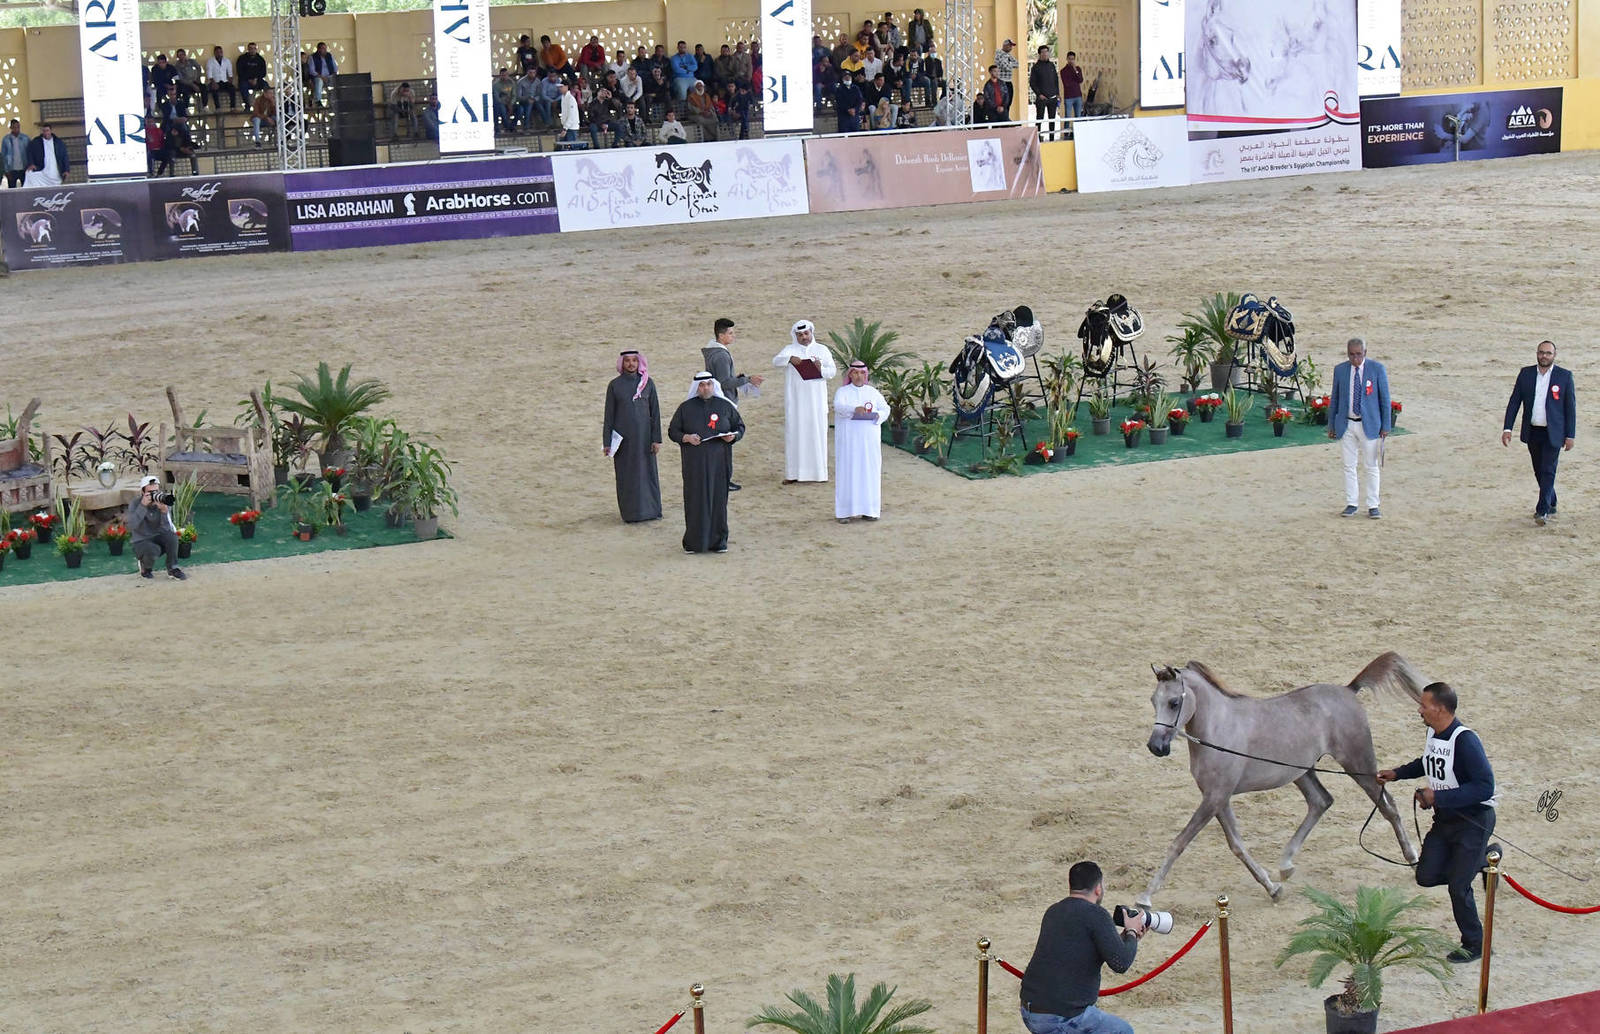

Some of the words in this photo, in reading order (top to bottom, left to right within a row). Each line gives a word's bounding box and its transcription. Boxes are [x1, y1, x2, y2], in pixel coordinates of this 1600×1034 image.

[1508, 114, 1536, 126] AEVA
[1382, 123, 1403, 131] MORE
[1367, 132, 1424, 144] EXPERIENCE
[1316, 159, 1350, 167] Championship
[647, 189, 664, 203] Al
[666, 185, 717, 209] Safinat
[296, 203, 327, 219] LISA
[329, 198, 394, 218] ABRAHAM
[1426, 754, 1446, 781] 113
